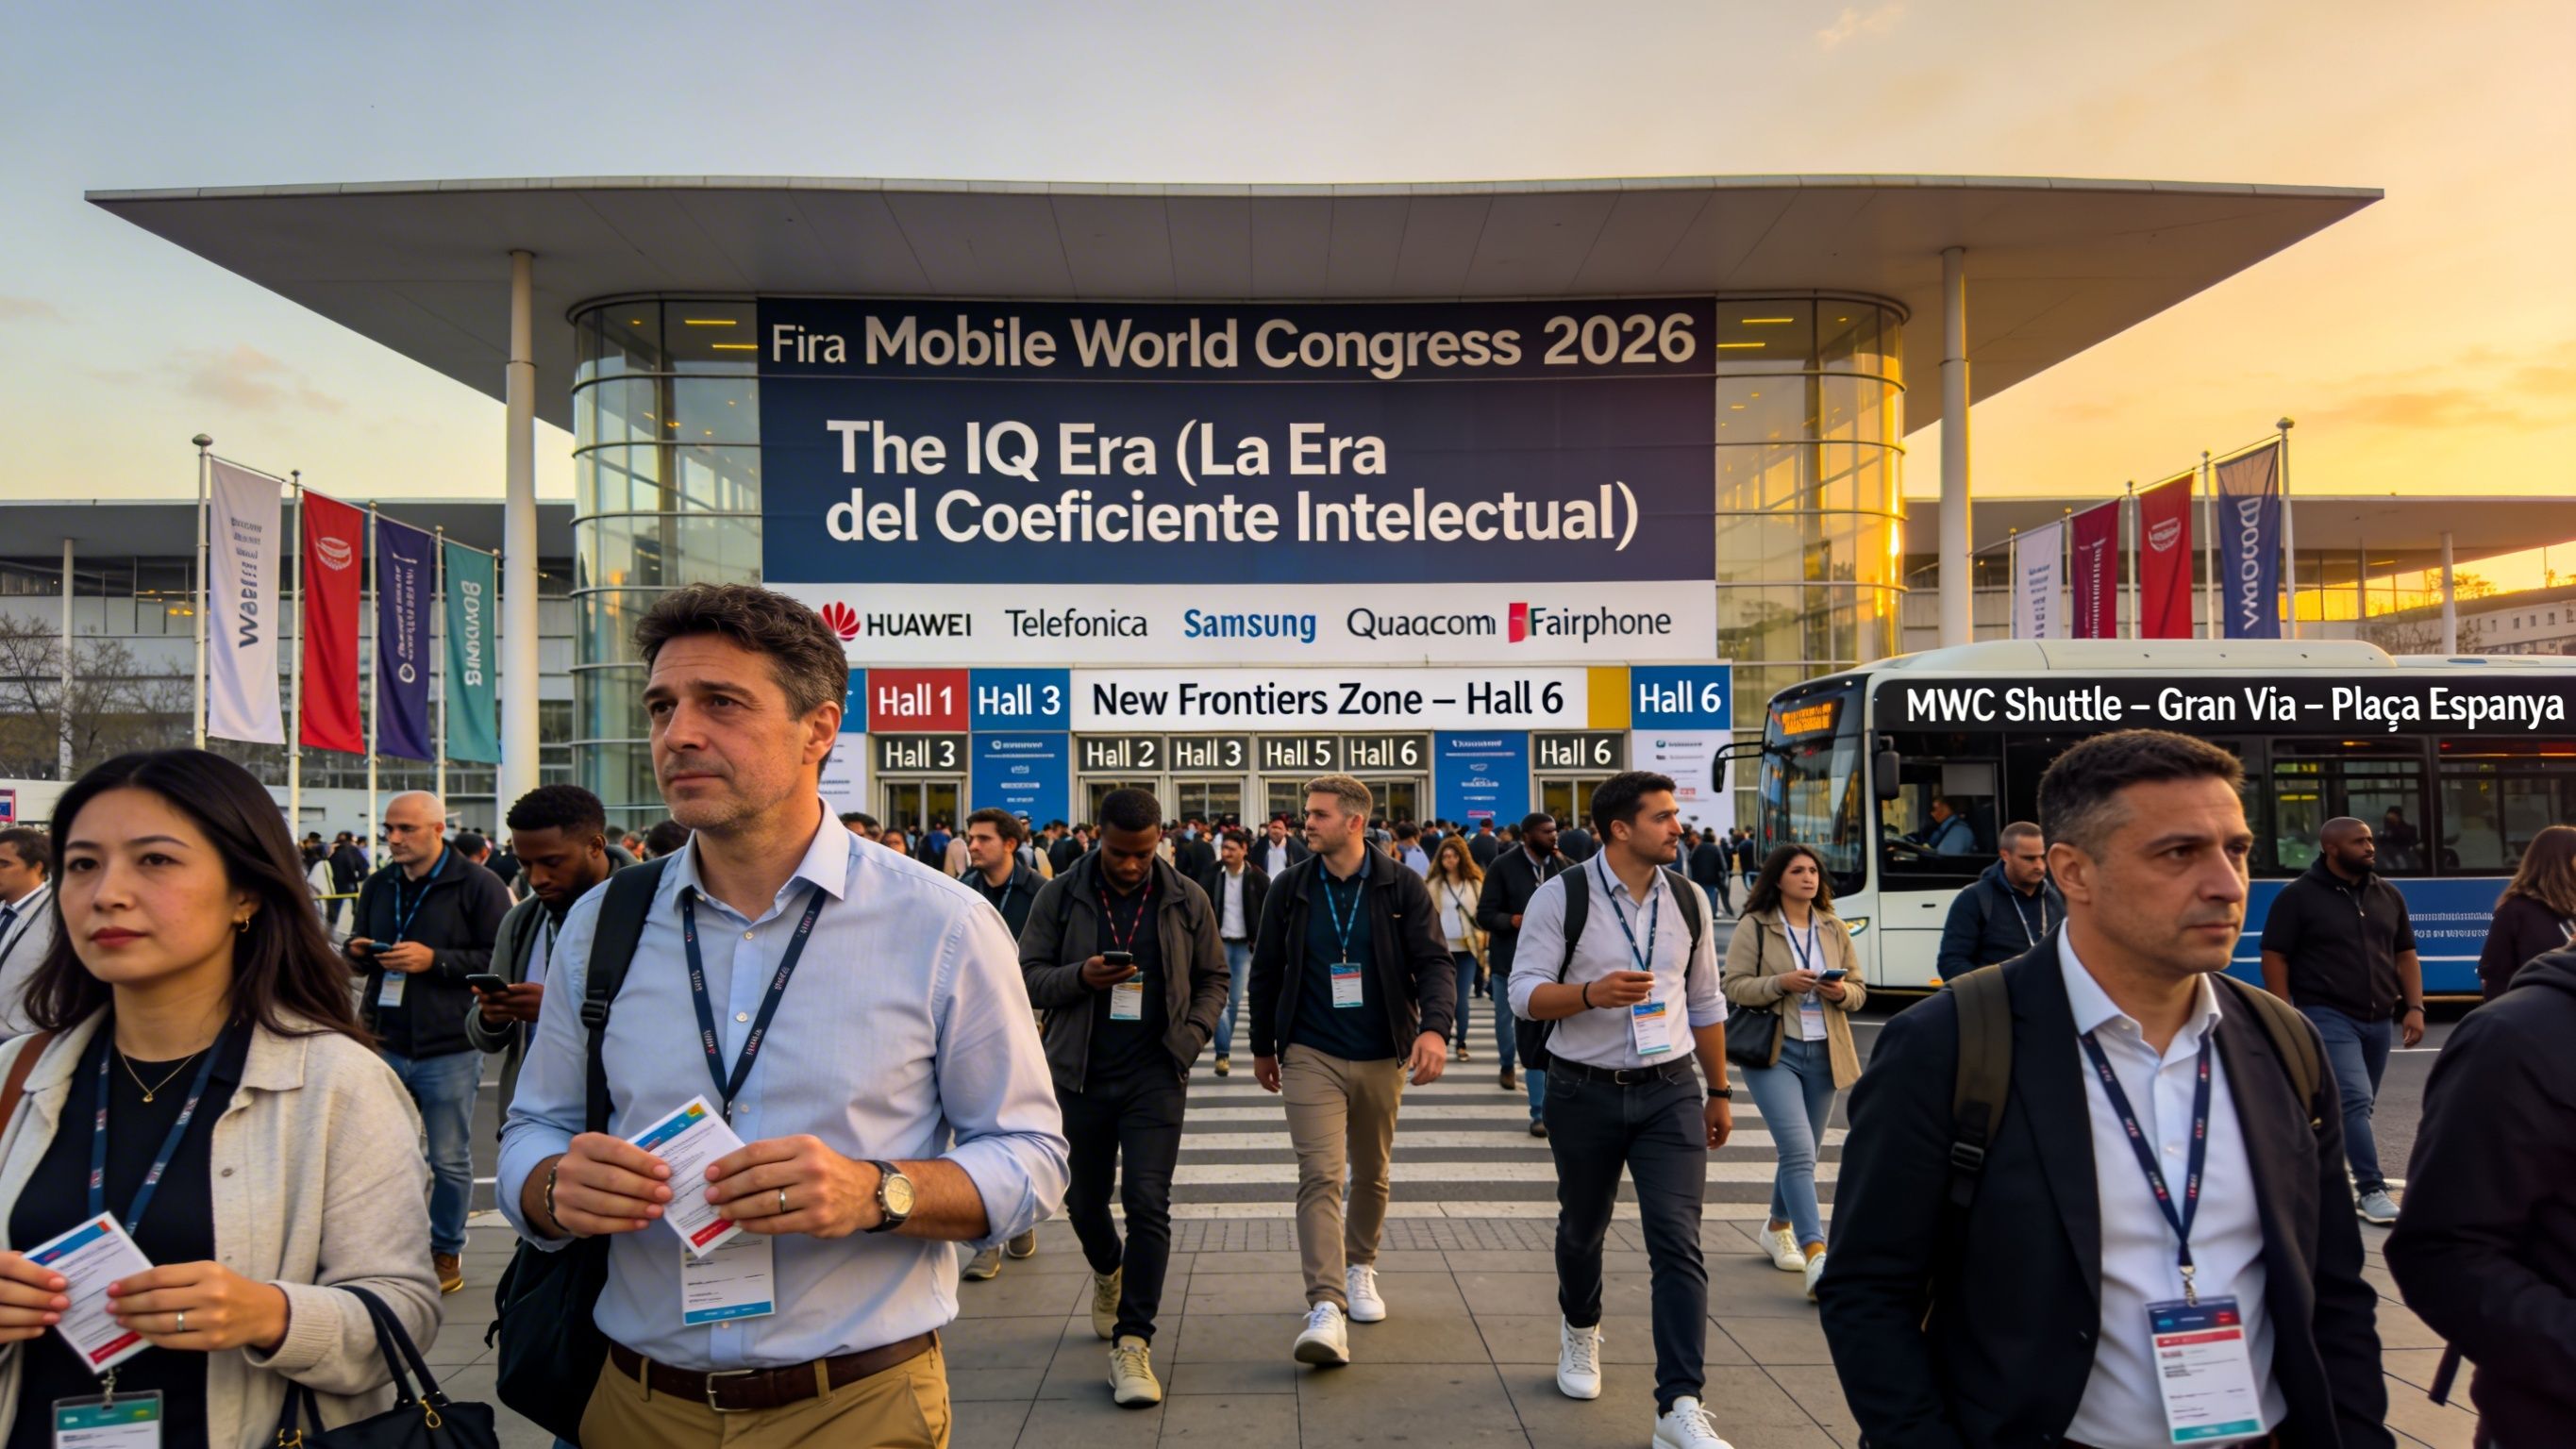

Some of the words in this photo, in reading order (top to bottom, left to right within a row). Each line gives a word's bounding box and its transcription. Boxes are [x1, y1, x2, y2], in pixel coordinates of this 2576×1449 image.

[773, 324, 846, 364] Fira
[865, 314, 1057, 367] Mobile
[1070, 318, 1239, 369] World
[1255, 319, 1522, 379] Congress
[1544, 312, 1696, 365] 2026
[827, 419, 946, 475] The
[966, 420, 1040, 482] IQ
[1059, 423, 1158, 476] Era
[1176, 419, 1270, 487] (La
[1289, 423, 1387, 475] Era
[826, 487, 919, 541] del
[935, 489, 1280, 542] Coeficiente
[1297, 480, 1638, 552] Intelectual)
[866, 612, 972, 637] HUAWEI
[1004, 608, 1148, 638] Telefonica
[1183, 608, 1316, 644] Samsung
[1530, 606, 1672, 643] Fairphone
[878, 683, 931, 717] Hall
[940, 686, 952, 715] 1
[979, 683, 1032, 716] Hall
[1041, 685, 1061, 715] 3
[1093, 683, 1169, 716] New
[1179, 681, 1329, 716] Frontiers
[1337, 682, 1423, 715] Zone
[1467, 679, 1533, 715] Hall
[1542, 681, 1564, 714] 6
[1639, 680, 1693, 713] Hall
[1700, 682, 1722, 713] 6
[1907, 688, 1996, 722] MWC
[2005, 685, 2122, 722] Shuttle
[2158, 687, 2236, 722] Gran
[2244, 686, 2297, 722] Via
[2332, 685, 2420, 733] Plaça
[2430, 687, 2565, 730] Espanya
[885, 739, 930, 769] Hall
[939, 741, 955, 767] 3
[1087, 739, 1131, 768] Hall
[1137, 741, 1155, 768] 2
[1176, 739, 1219, 767] Hall
[1225, 741, 1242, 767] 3
[1266, 739, 1309, 767] Hall
[1314, 740, 1331, 766] 5
[1350, 738, 1395, 767] Hall
[1400, 740, 1418, 766] 6
[1541, 738, 1585, 767] Hall
[1594, 739, 1612, 765] 6
